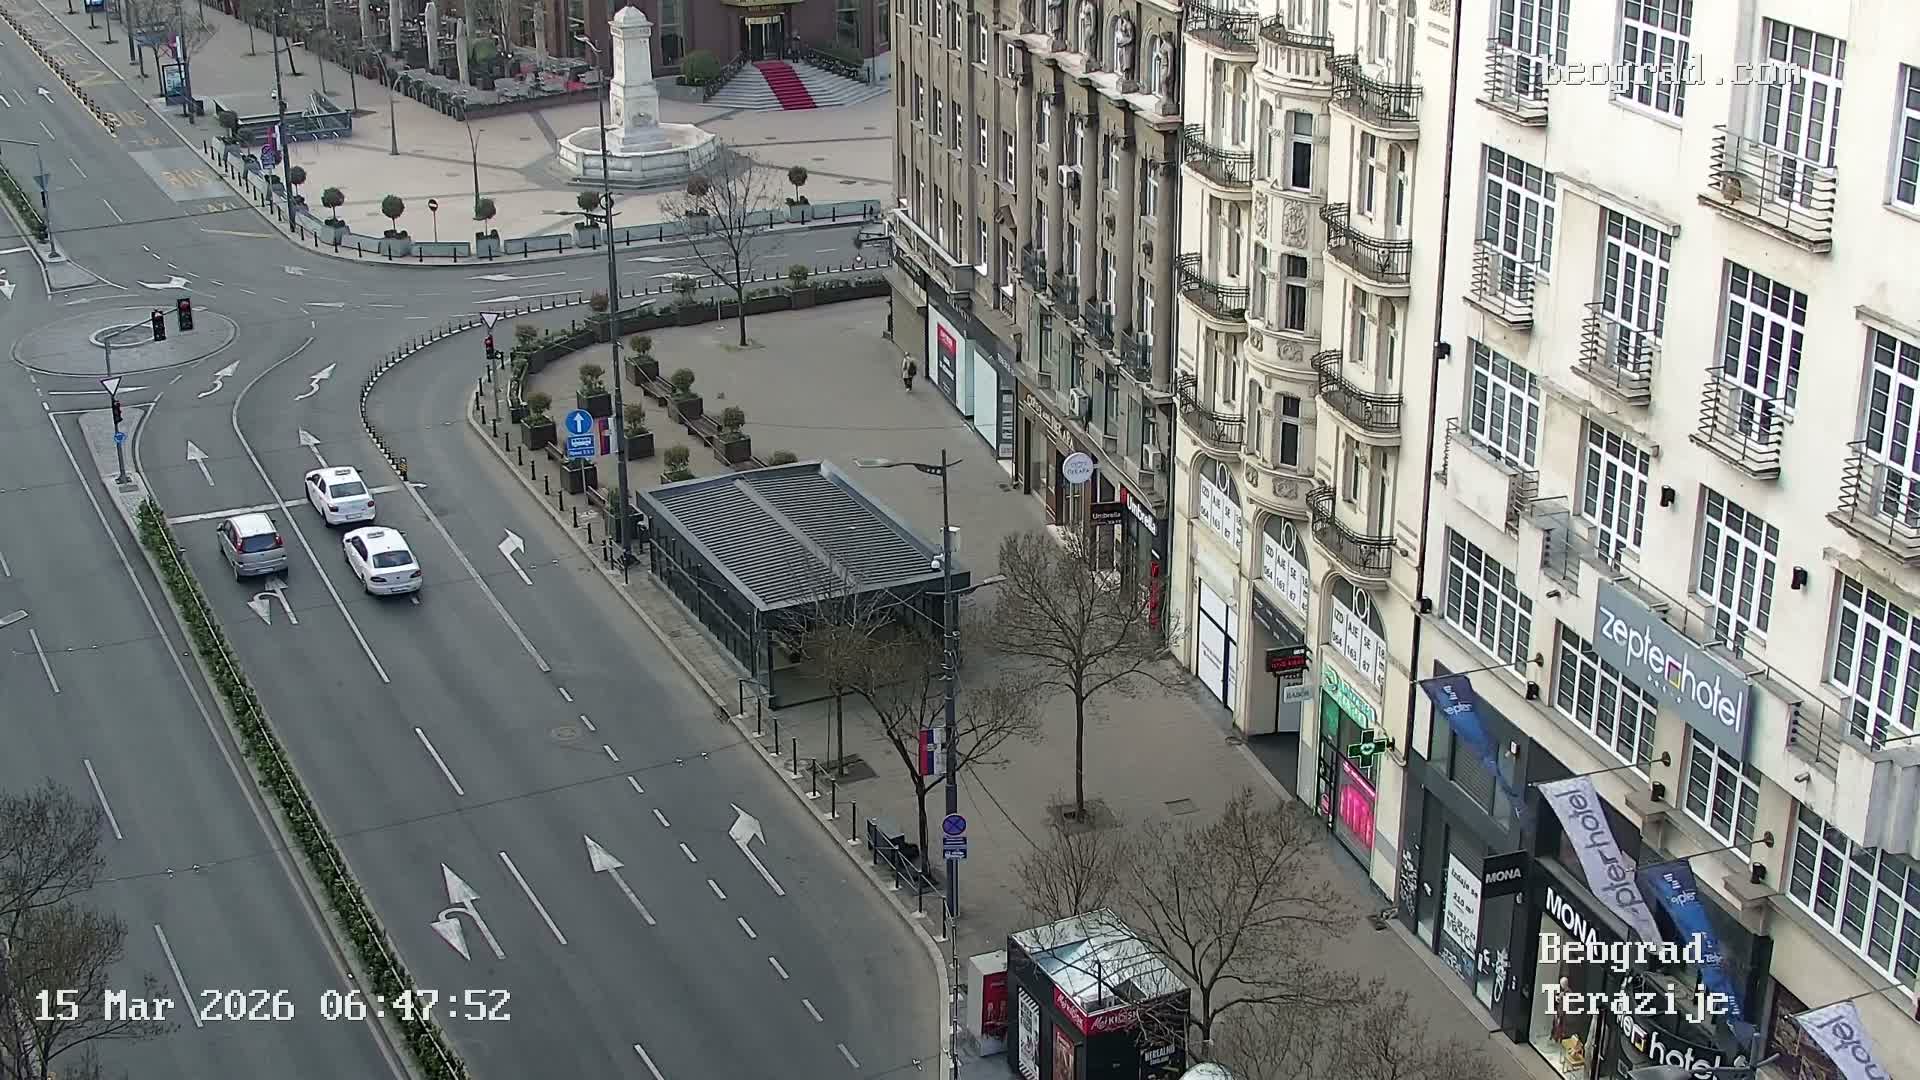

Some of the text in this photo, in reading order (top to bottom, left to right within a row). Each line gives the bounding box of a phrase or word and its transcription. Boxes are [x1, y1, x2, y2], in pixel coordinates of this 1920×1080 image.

[1092, 511, 1121, 520] Umbrella
[1127, 493, 1157, 536] Umbrella
[1201, 484, 1210, 499] IZD
[1212, 496, 1221, 510] AJE
[1224, 505, 1231, 518] SE
[1265, 544, 1274, 559] IZD
[1277, 554, 1286, 570] AJE
[1289, 565, 1297, 580] SE
[1334, 608, 1344, 624] IZD
[1348, 621, 1359, 638] AJE
[1363, 635, 1372, 650] SE
[1485, 867, 1522, 884] MONA
[1546, 887, 1598, 955] MONA
